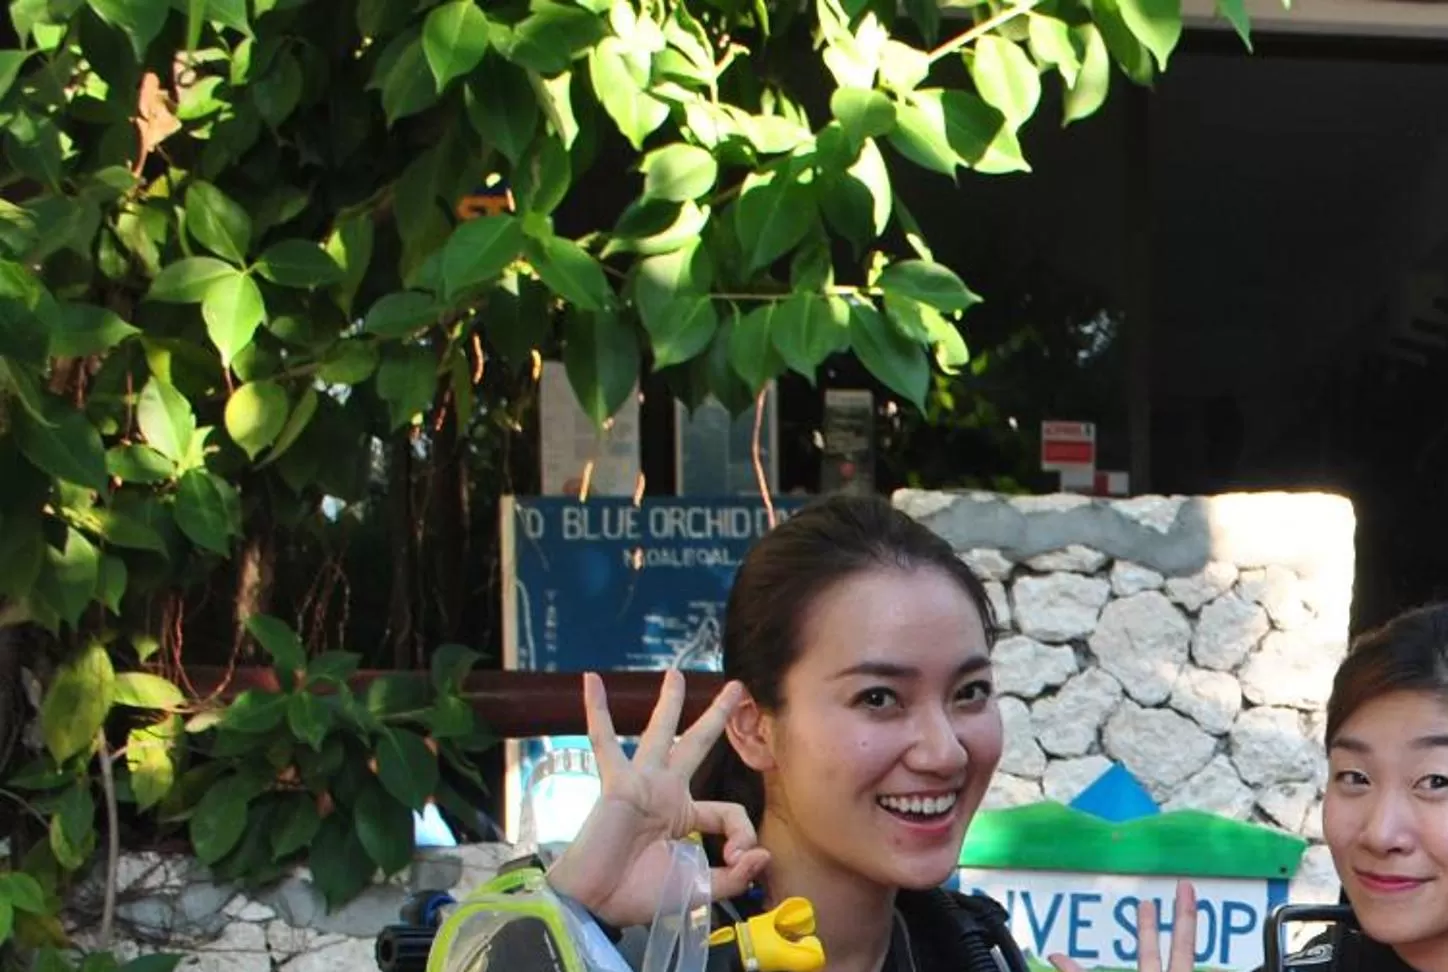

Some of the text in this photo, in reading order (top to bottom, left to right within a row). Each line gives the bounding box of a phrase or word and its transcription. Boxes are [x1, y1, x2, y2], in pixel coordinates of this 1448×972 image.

[563, 506, 641, 540] BLUE
[650, 506, 750, 540] ORCHID
[971, 887, 1100, 960] IVE
